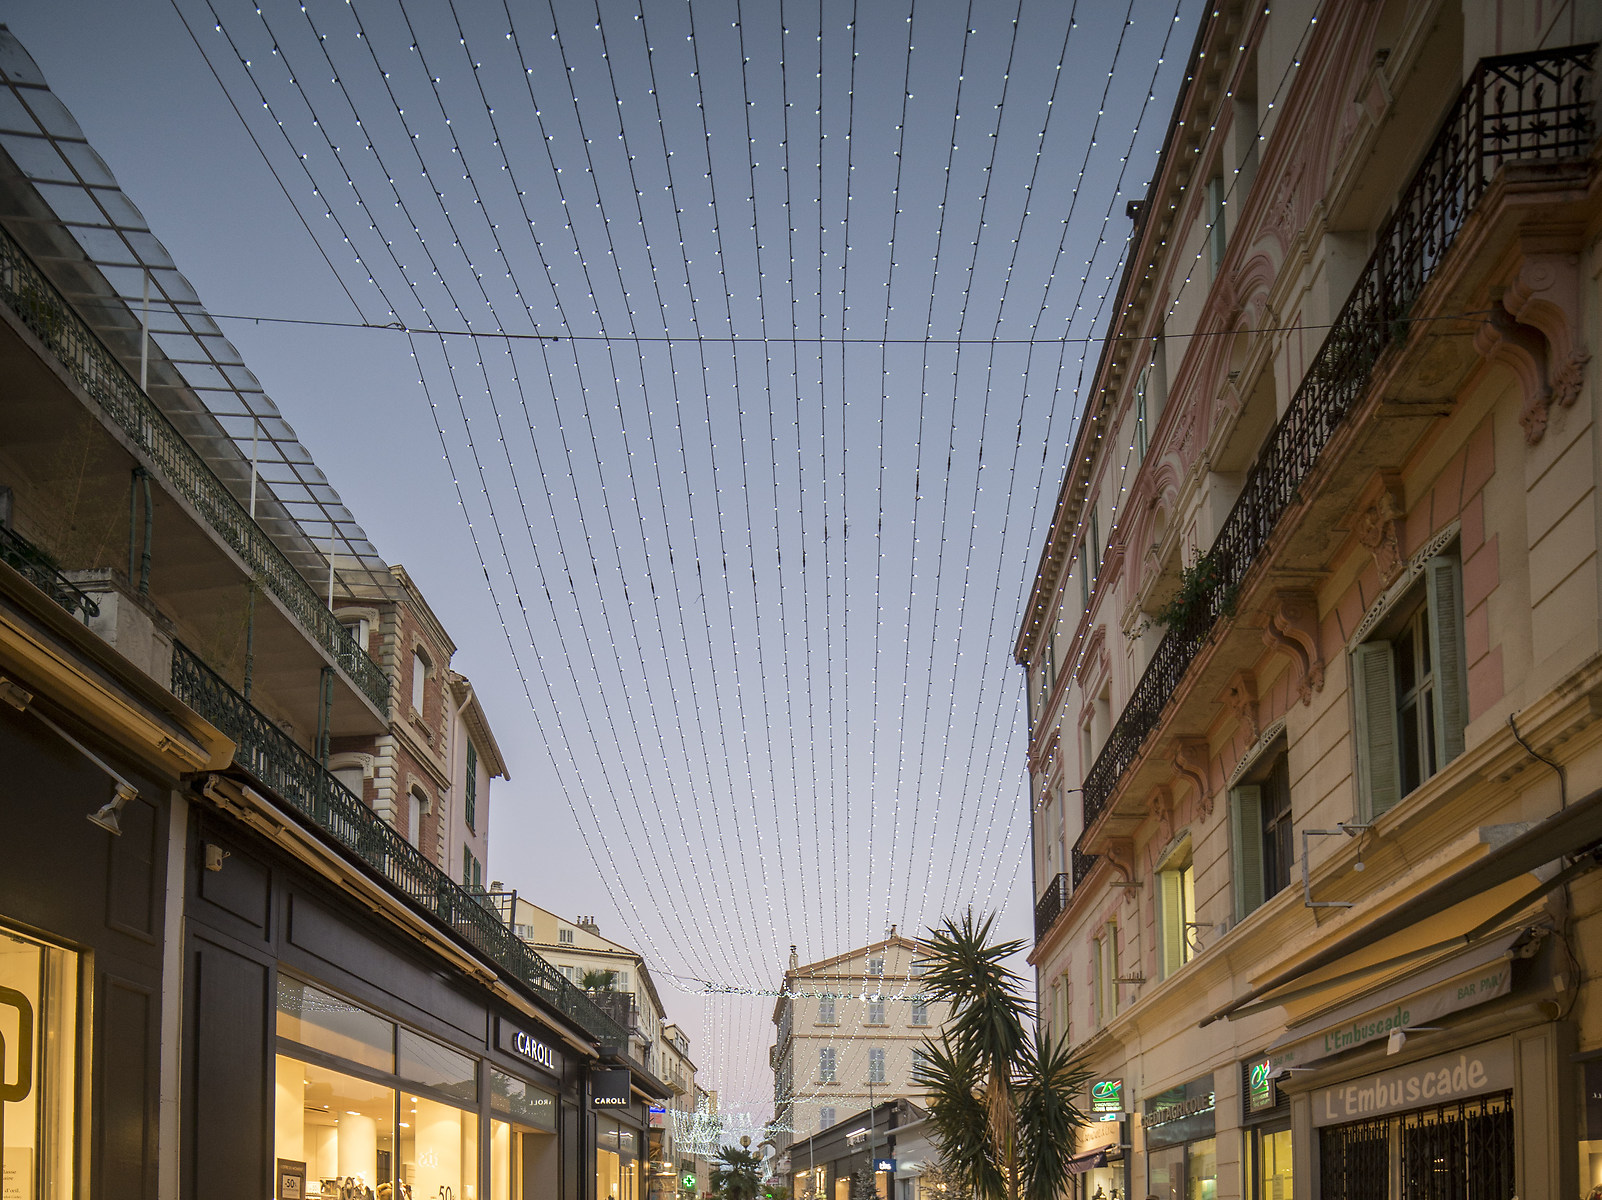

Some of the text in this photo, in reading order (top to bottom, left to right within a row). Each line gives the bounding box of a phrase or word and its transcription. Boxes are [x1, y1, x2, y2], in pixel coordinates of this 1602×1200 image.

[1457, 982, 1476, 1000] BAR
[1324, 1006, 1411, 1053] L'Embuscade
[517, 1031, 554, 1070] CAROLL
[594, 1097, 627, 1105] CAROLL
[1326, 1055, 1488, 1120] L'Embuscade
[1166, 1094, 1209, 1121] AGRICOLE
